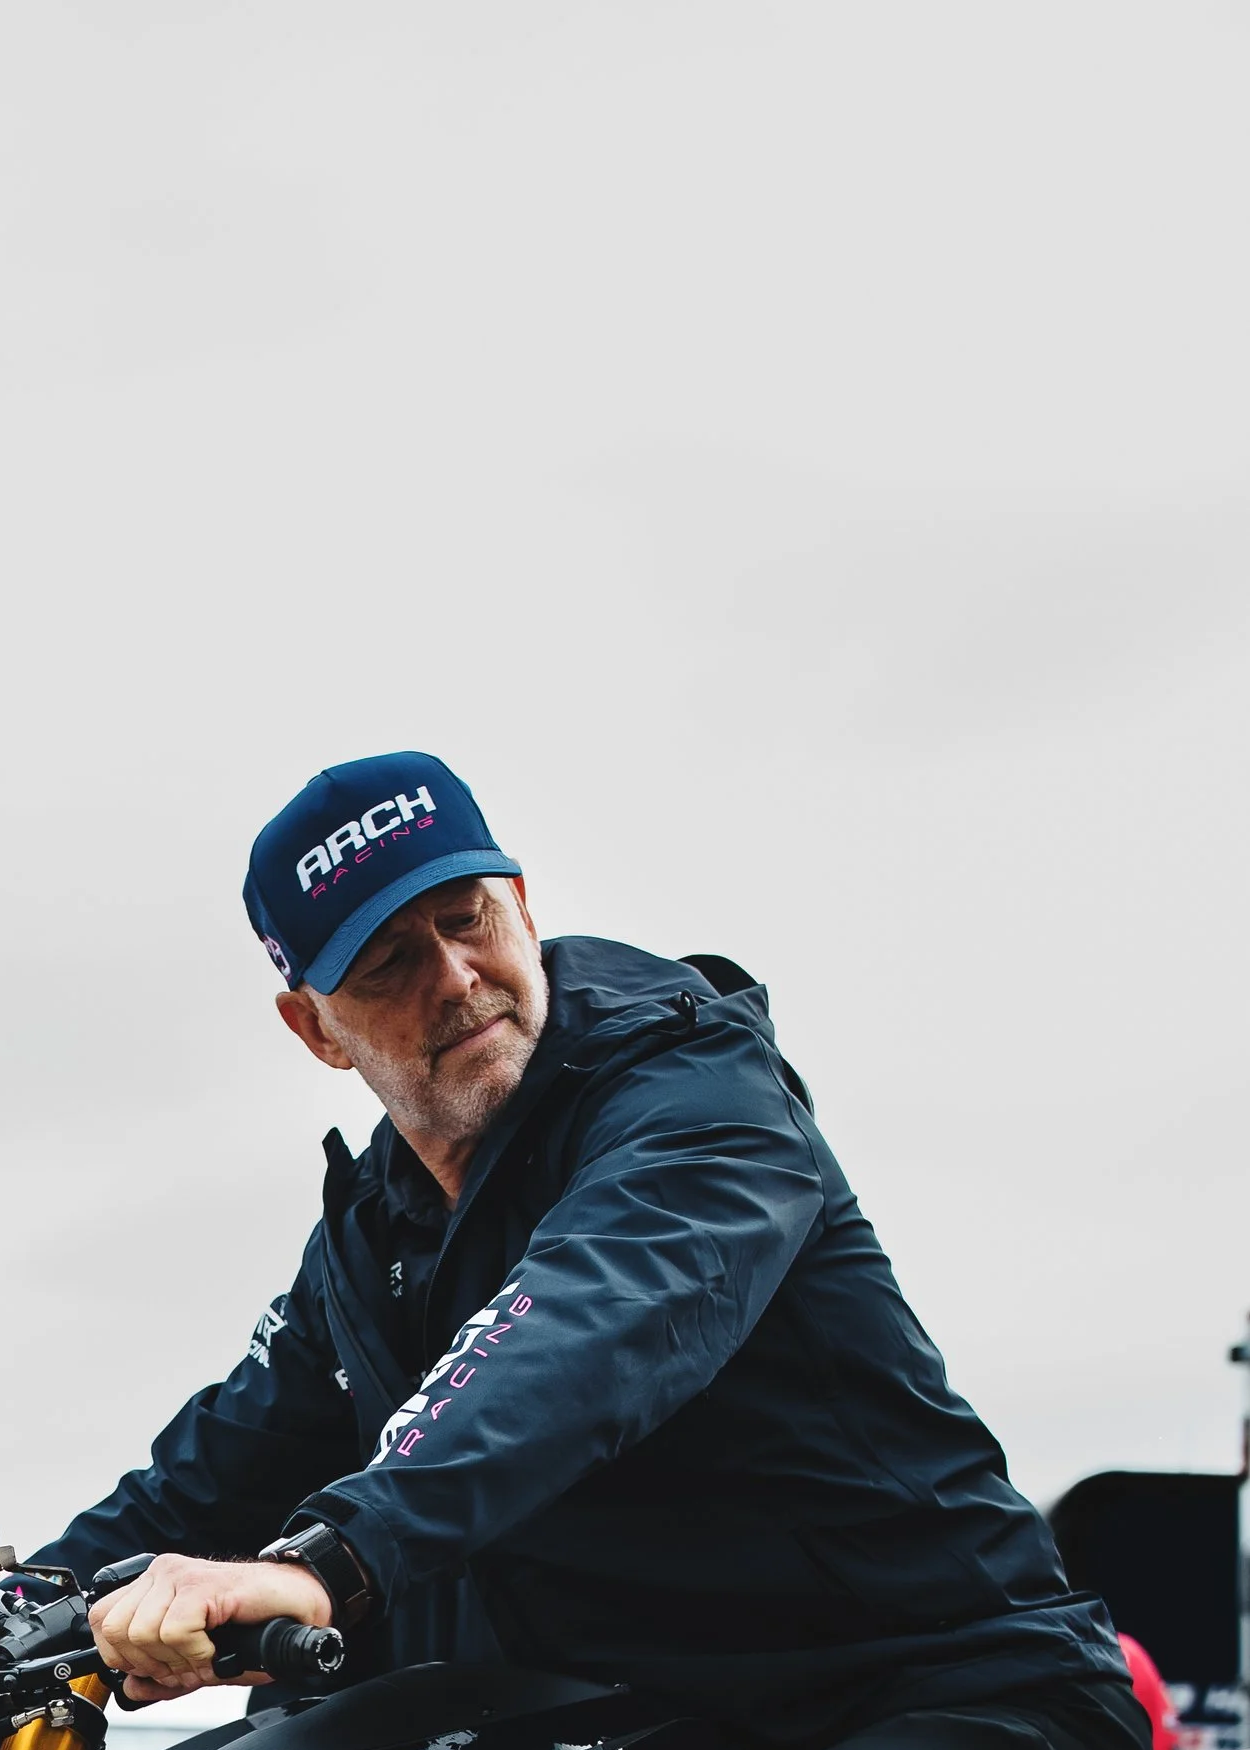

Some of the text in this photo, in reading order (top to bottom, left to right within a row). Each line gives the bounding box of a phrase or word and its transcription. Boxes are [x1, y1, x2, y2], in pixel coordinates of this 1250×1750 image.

[296, 785, 437, 893] ARCH
[311, 815, 435, 900] RACING
[396, 1293, 533, 1457] RACING
